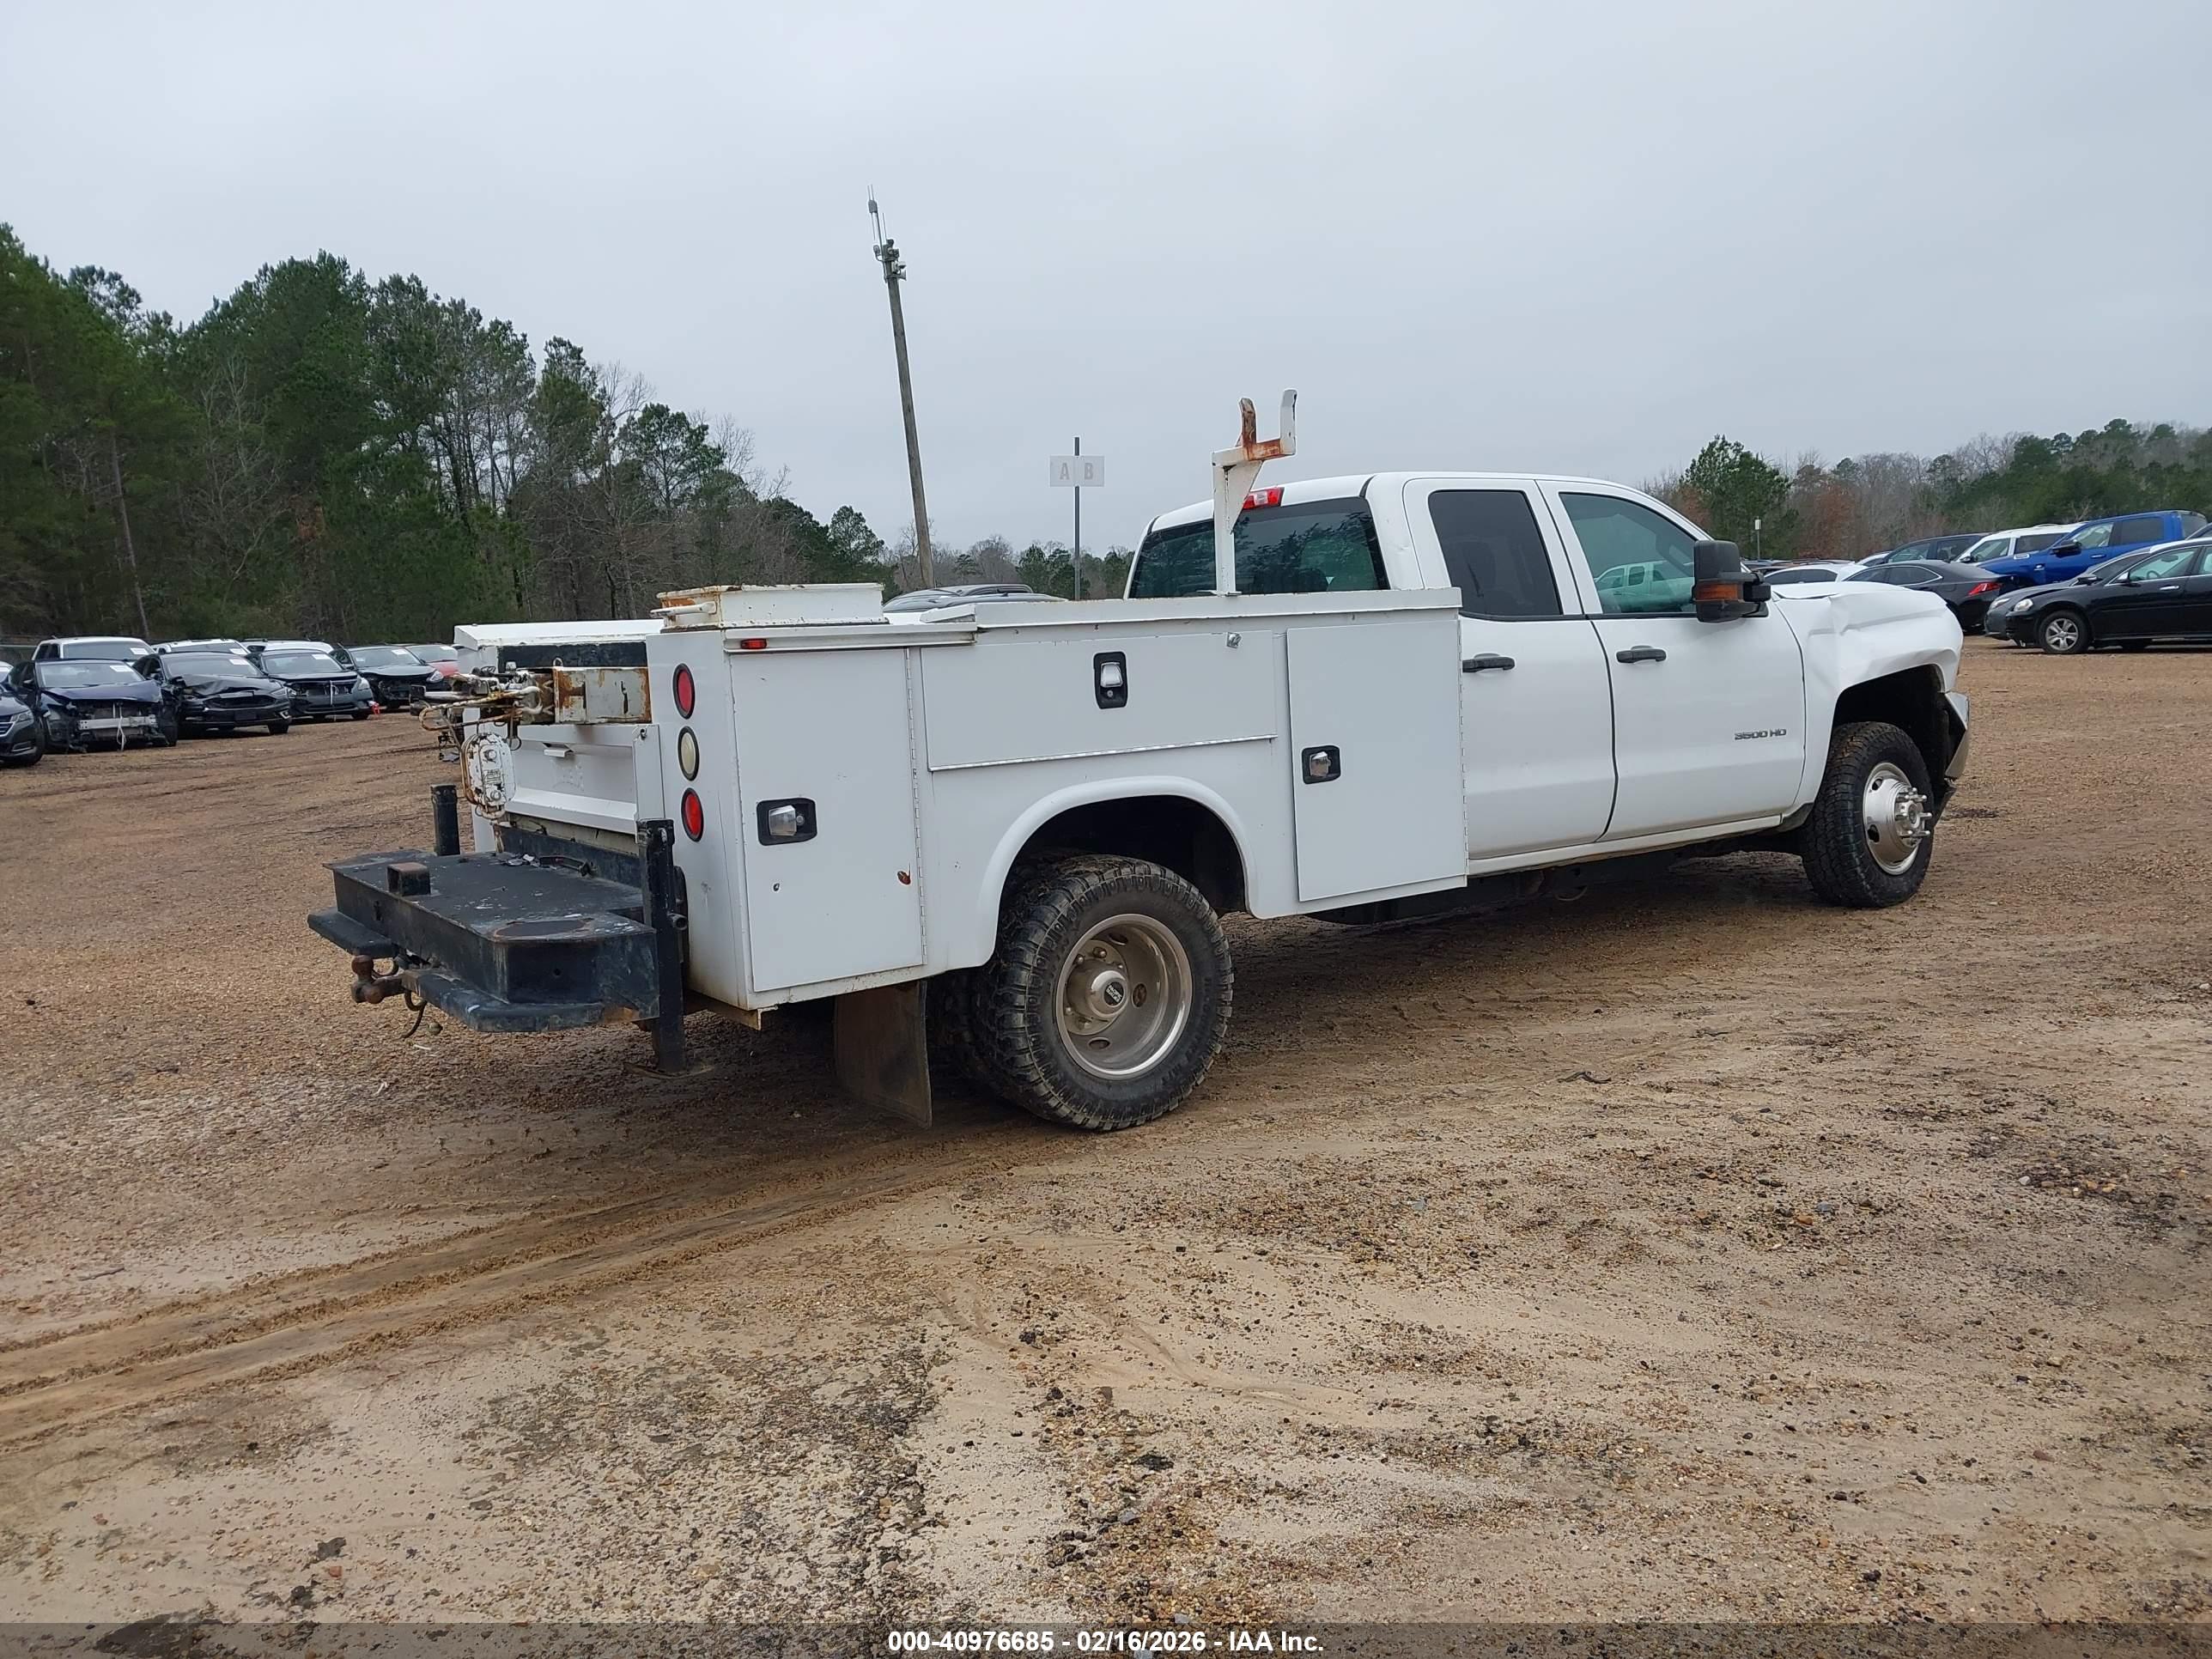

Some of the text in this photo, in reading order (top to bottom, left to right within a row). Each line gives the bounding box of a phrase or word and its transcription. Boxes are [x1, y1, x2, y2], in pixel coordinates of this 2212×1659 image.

[1060, 463, 1093, 480] A B
[1735, 728, 1787, 740] 3500 HD
